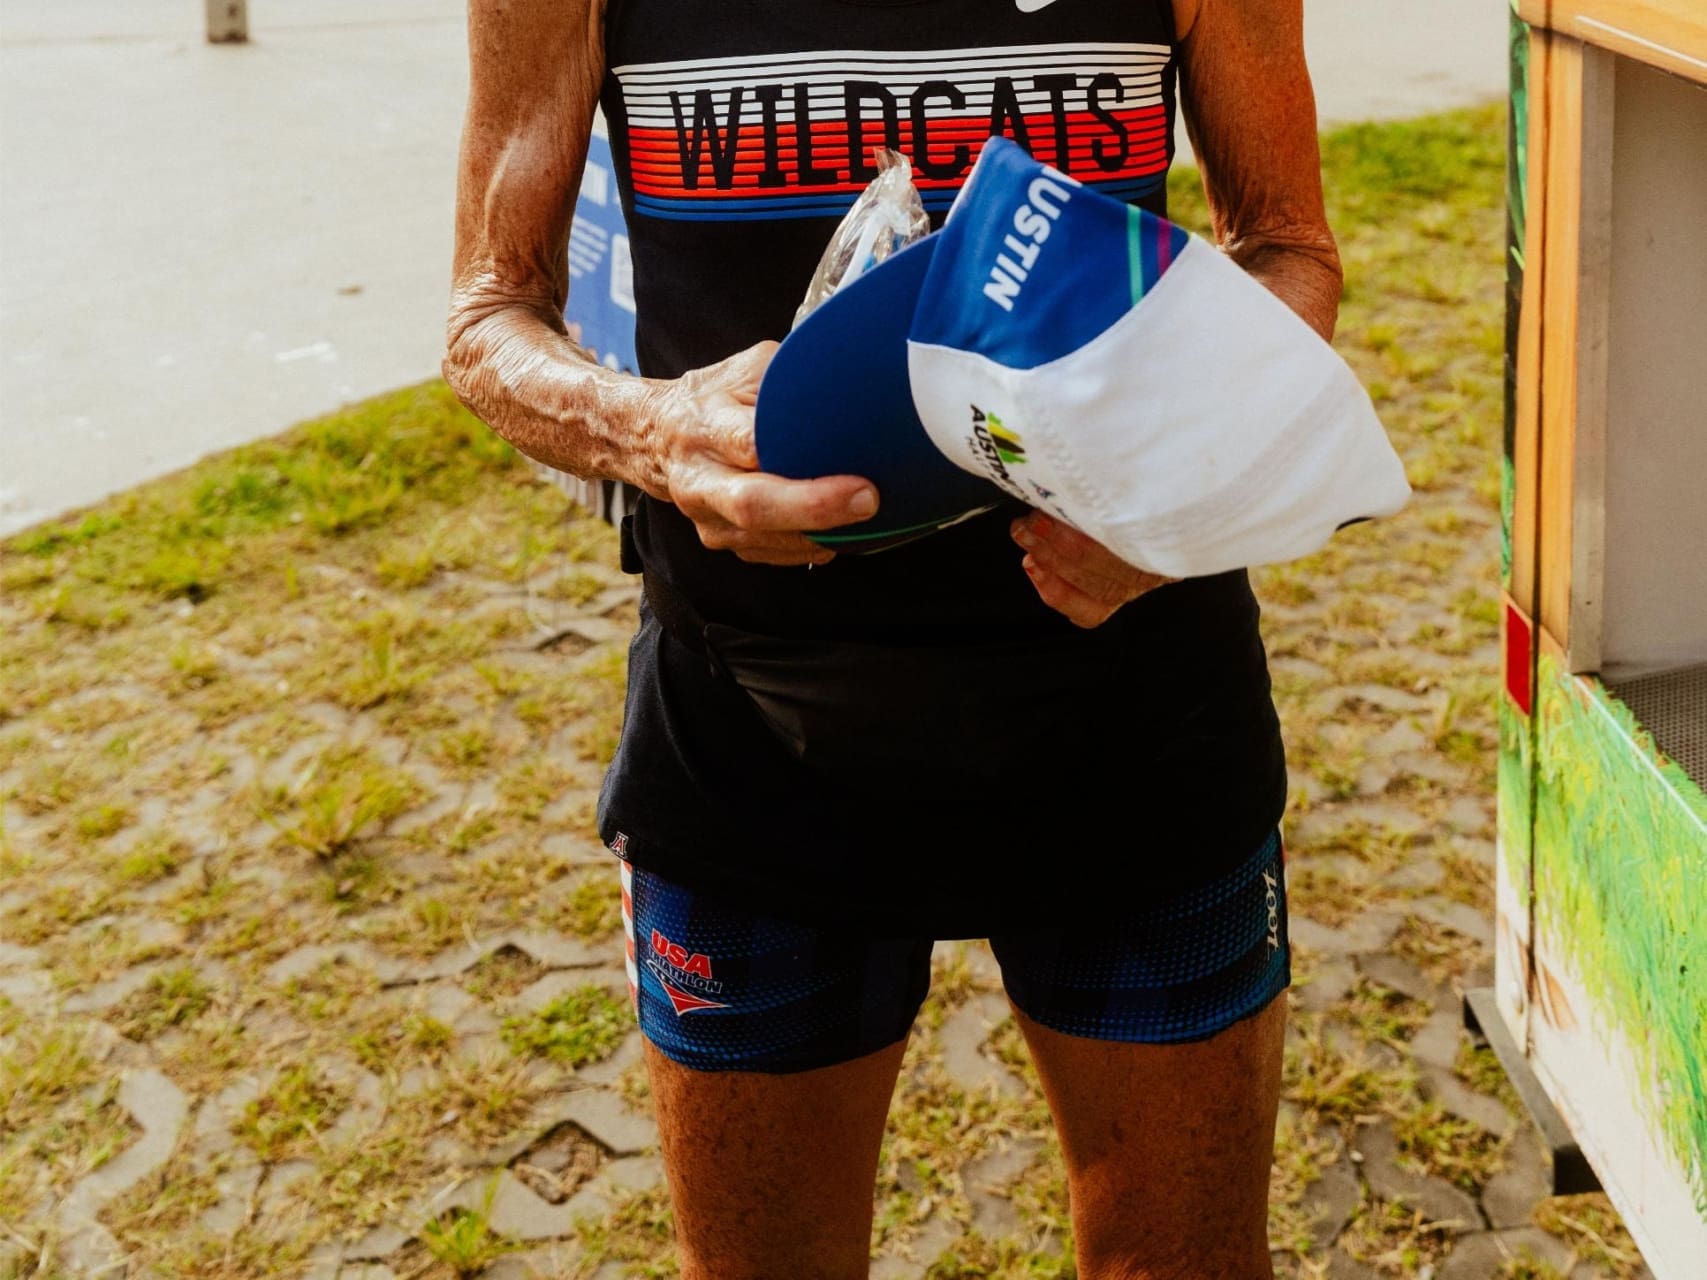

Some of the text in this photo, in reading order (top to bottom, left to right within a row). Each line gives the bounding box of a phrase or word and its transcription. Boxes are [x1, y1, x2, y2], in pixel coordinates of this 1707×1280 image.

[668, 72, 1130, 191] WILDCATS
[648, 943, 723, 994] TRIATHLON
[651, 928, 713, 980] USA
